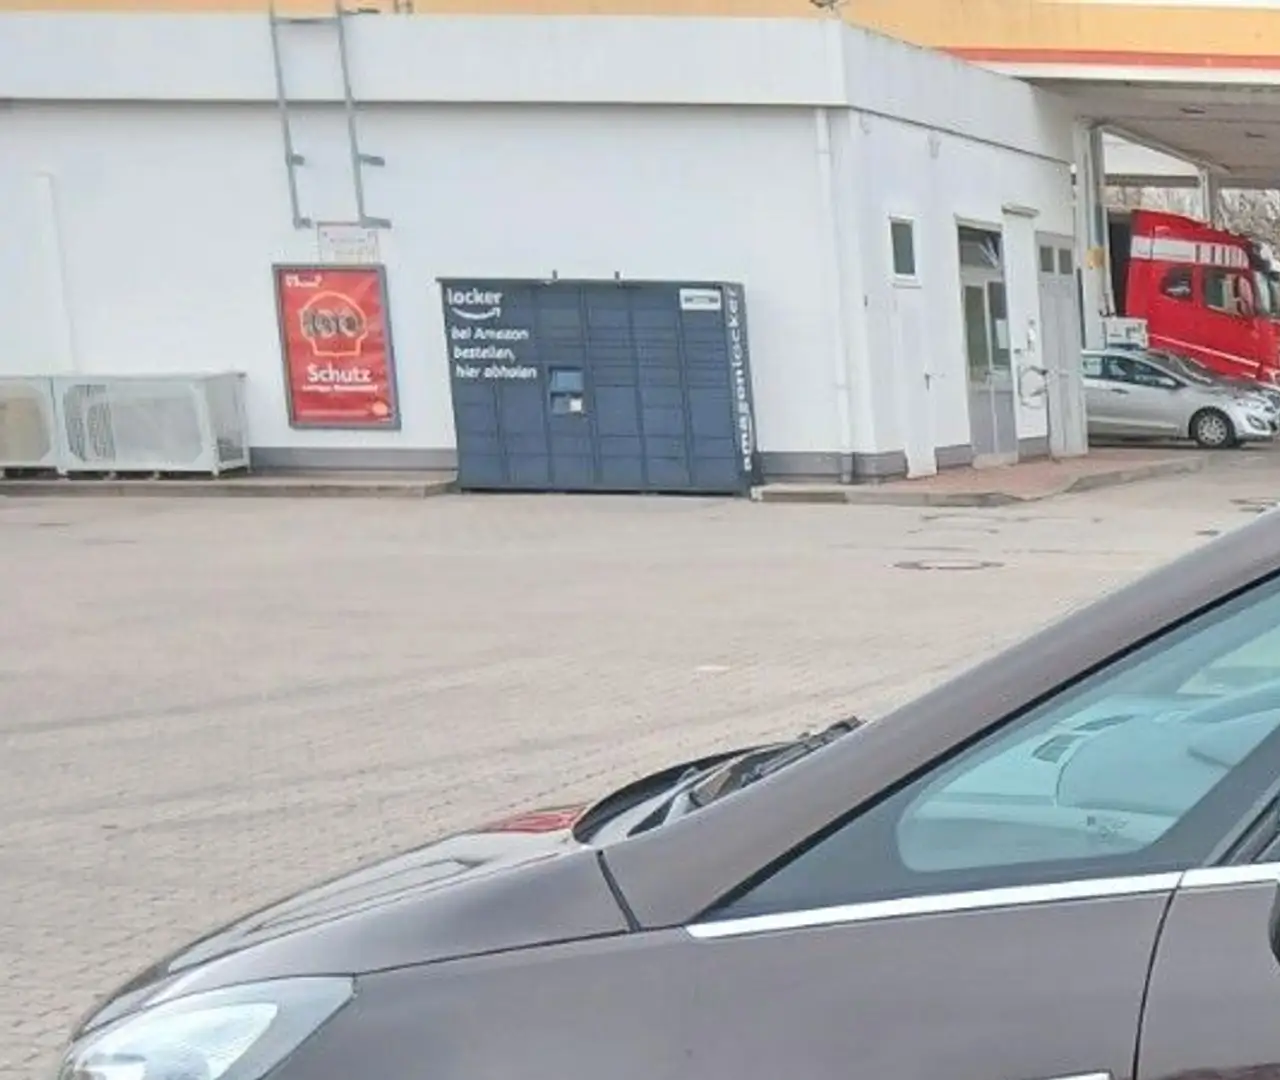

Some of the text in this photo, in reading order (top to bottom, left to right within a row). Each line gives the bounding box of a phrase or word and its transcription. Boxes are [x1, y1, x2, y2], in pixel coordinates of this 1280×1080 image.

[446, 287, 503, 305] locker
[473, 327, 530, 341] Amazon
[306, 362, 373, 383] Schutz
